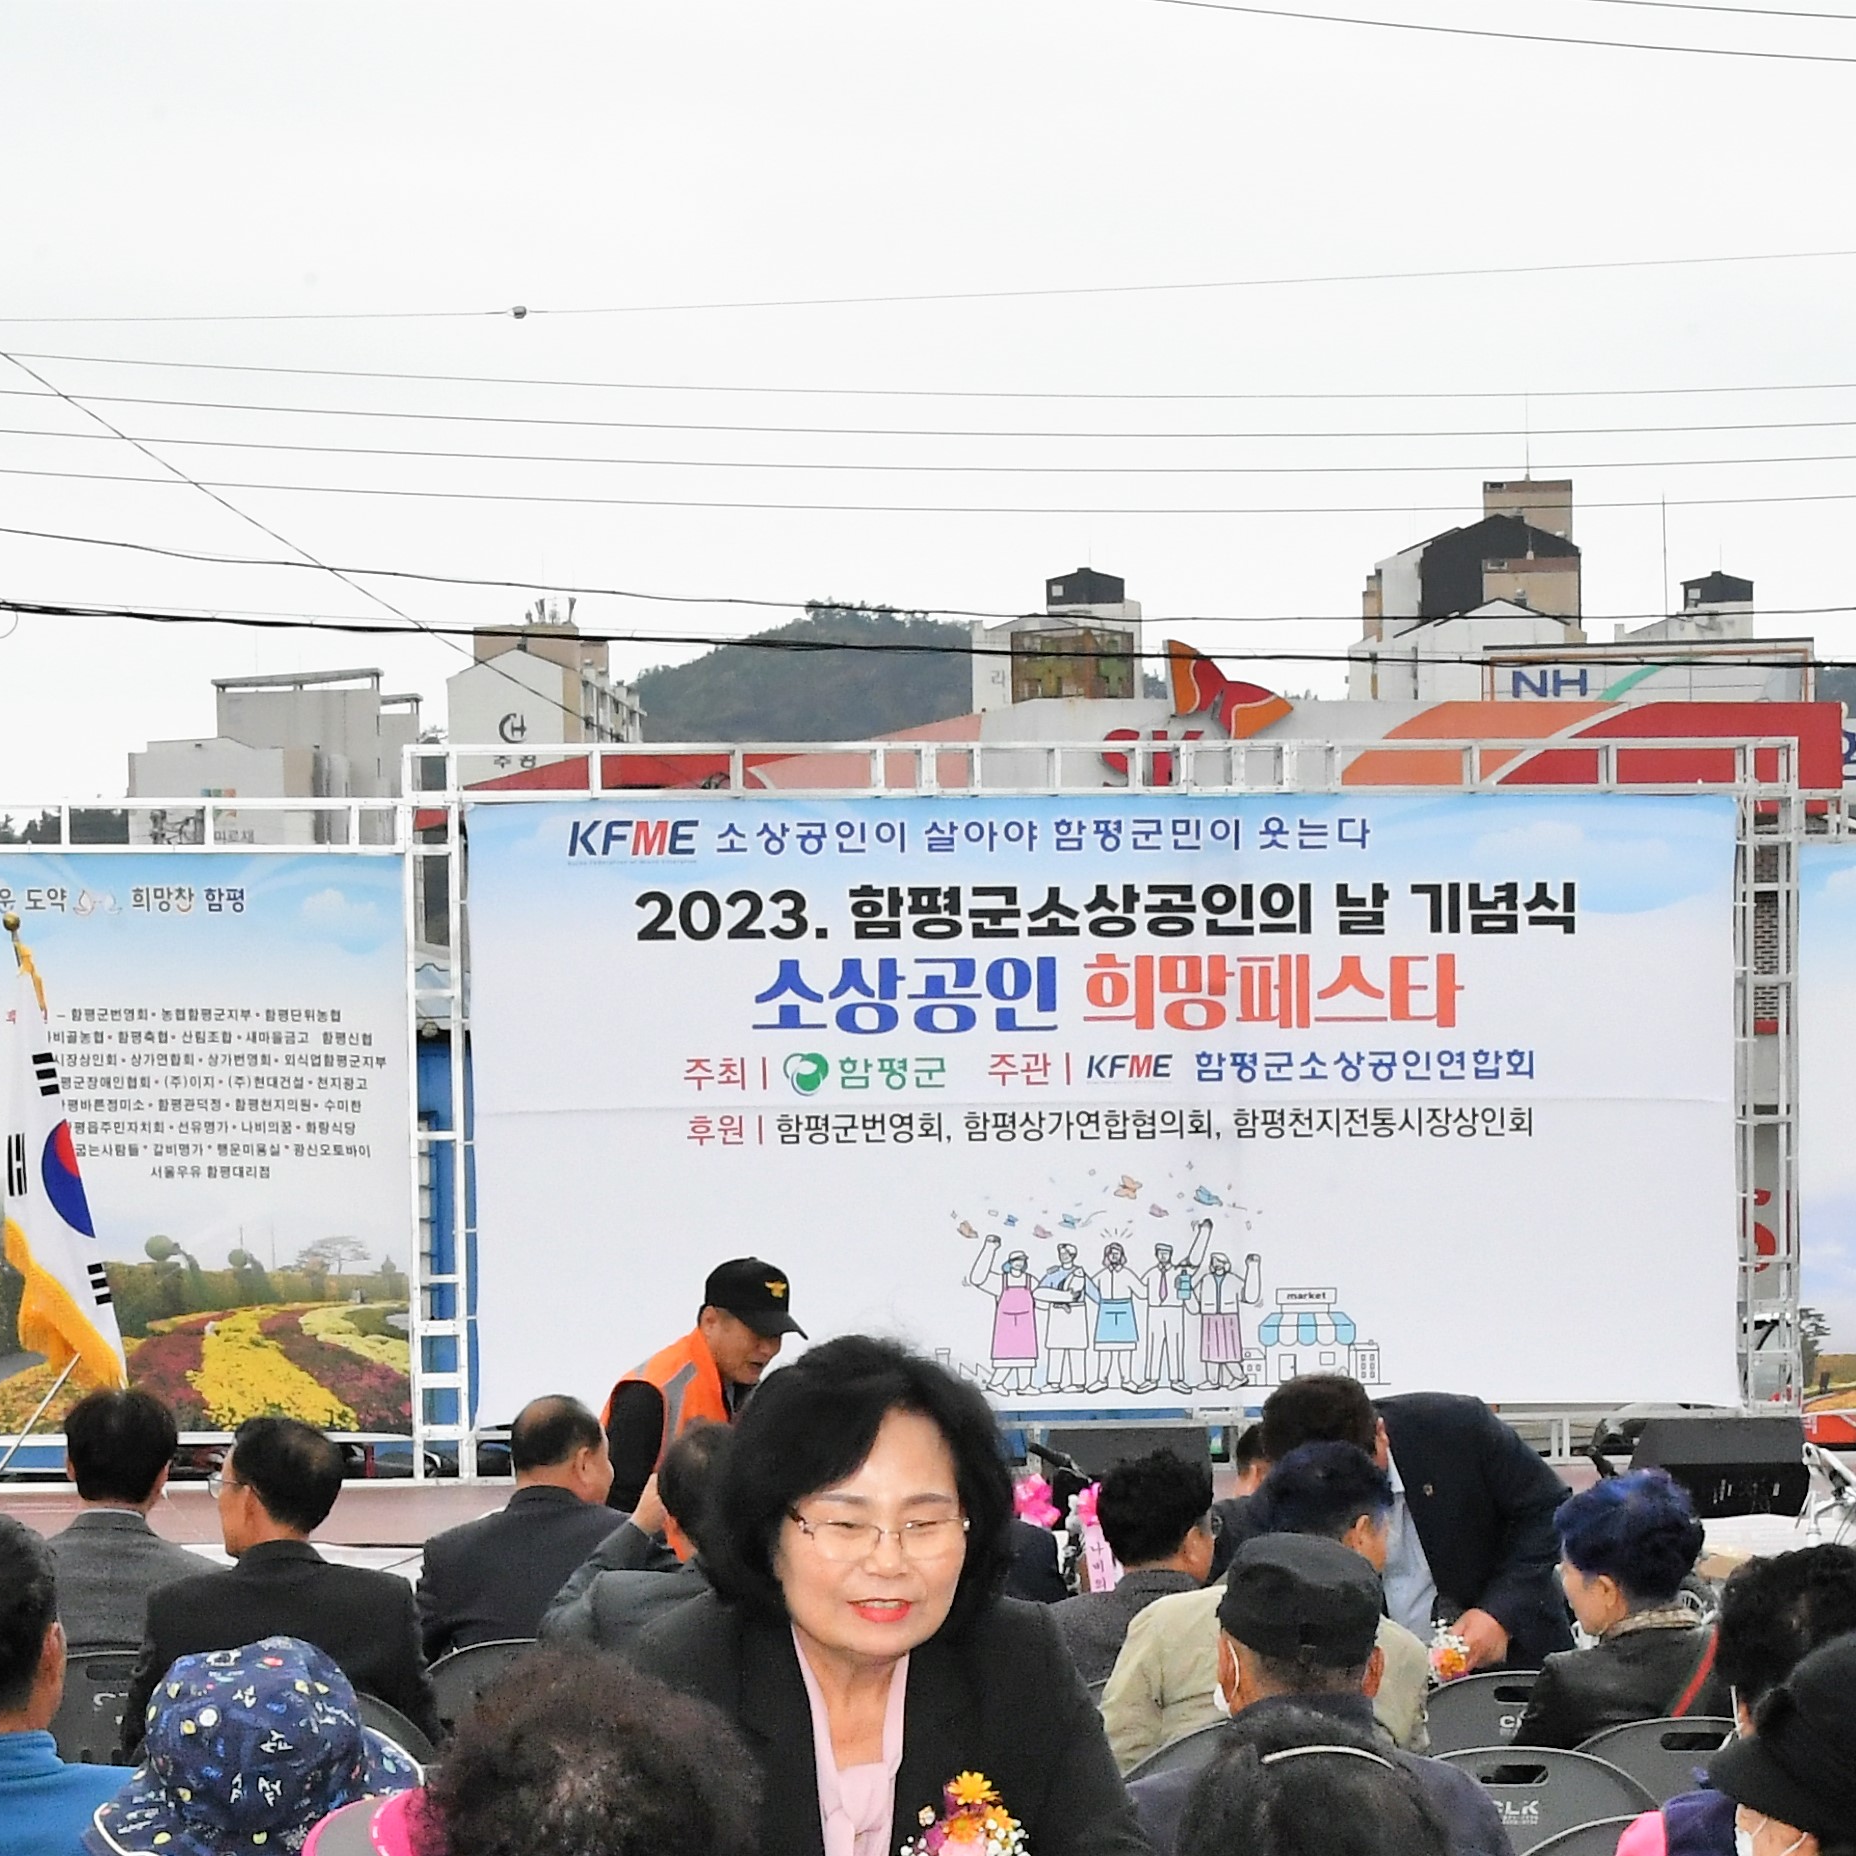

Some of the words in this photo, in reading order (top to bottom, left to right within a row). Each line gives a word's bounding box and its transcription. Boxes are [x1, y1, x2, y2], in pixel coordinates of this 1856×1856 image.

[1512, 668, 1587, 698] NH
[568, 820, 700, 857] KFME
[716, 821, 906, 856] 소상공인이
[924, 819, 1038, 854] 살아야
[1053, 816, 1242, 853] 함평군민이
[1258, 816, 1372, 851] 웃는다
[24, 887, 67, 913] 도약
[204, 887, 245, 914] 함평
[635, 889, 828, 941] 2023.
[849, 882, 1312, 940] 함평군소상공인의
[1335, 881, 1389, 938] 날
[1410, 881, 1576, 936] 기념식
[751, 956, 1058, 1035] 소상공인
[1082, 952, 1465, 1032] 희망페스타
[47, 1030, 104, 1044] 비골농협
[684, 1056, 747, 1092] 주최
[838, 1056, 946, 1090] 함평군
[988, 1053, 1051, 1088] 주관
[1087, 1054, 1173, 1078] KFME
[1194, 1048, 1536, 1084] 함평군소상공인연합회
[686, 1113, 745, 1148] 후원
[775, 1112, 952, 1146] 함평군번영회,
[964, 1109, 1222, 1145] 함평상가연합협의회,
[1233, 1107, 1534, 1140] 함평천지전통시장상인회
[1287, 1291, 1326, 1300] market
